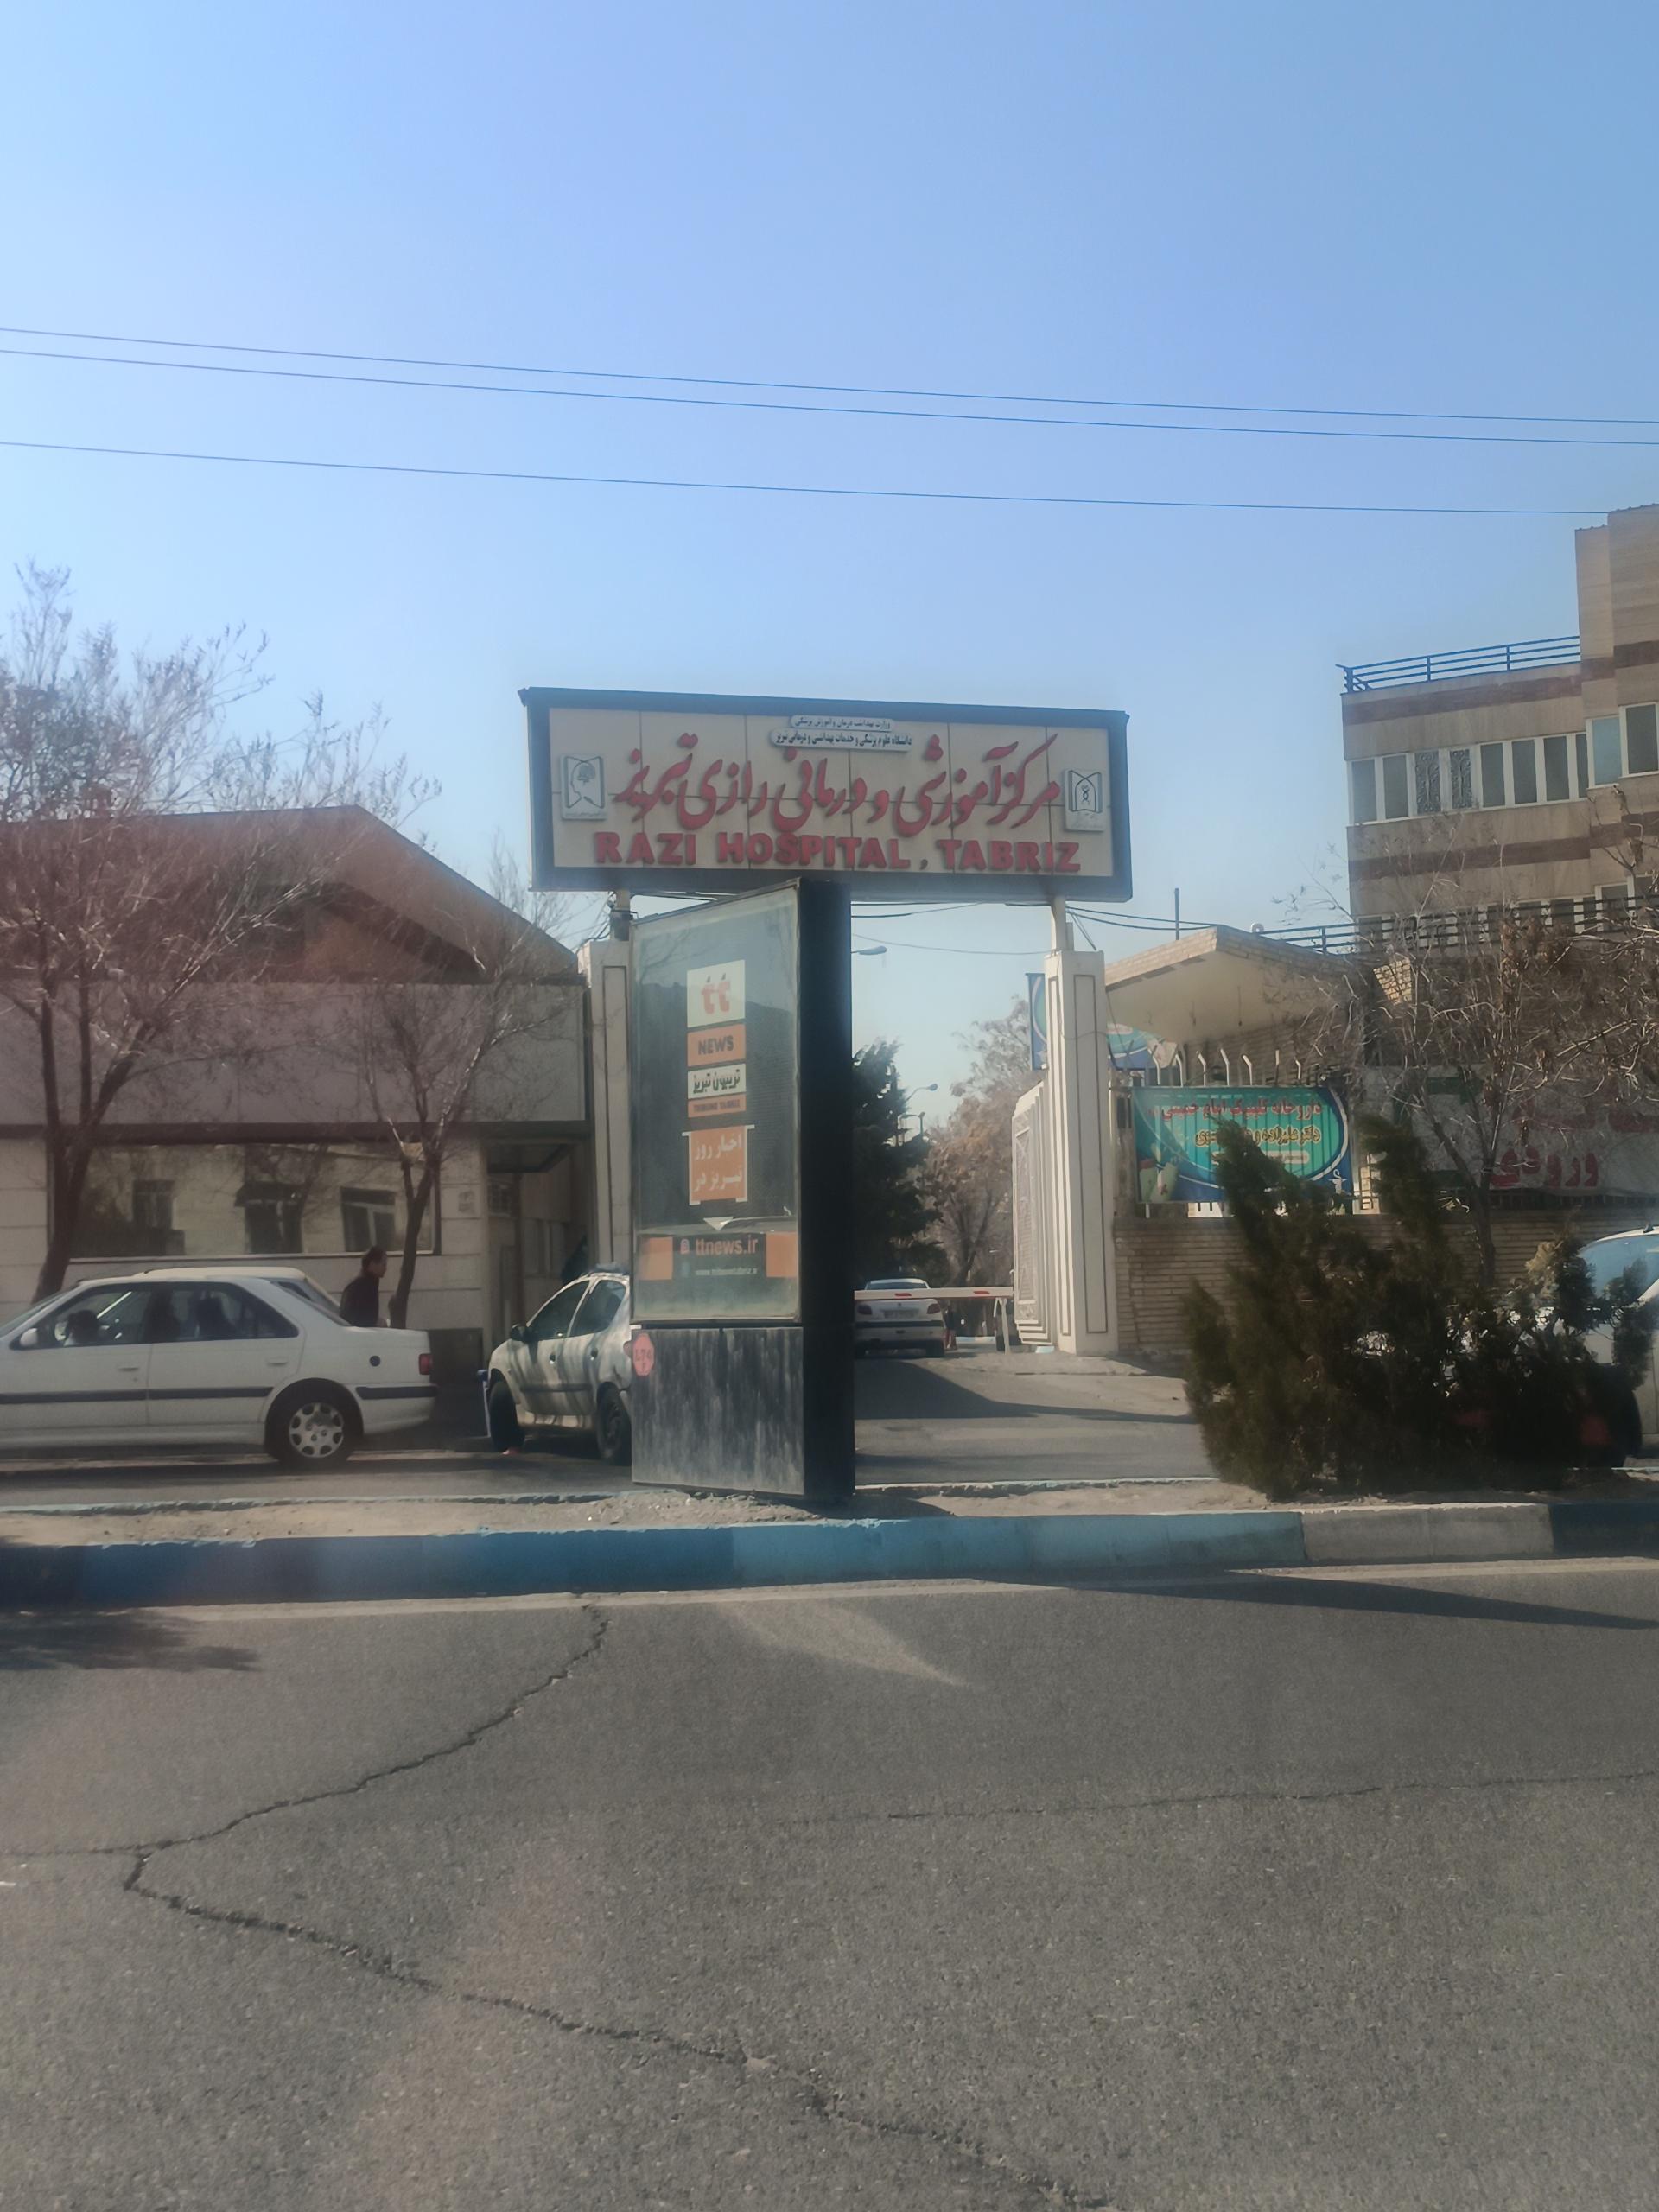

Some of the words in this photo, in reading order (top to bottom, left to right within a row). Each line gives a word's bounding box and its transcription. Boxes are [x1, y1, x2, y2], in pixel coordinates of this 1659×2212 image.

[611, 732, 699, 823] تبریز
[677, 758, 769, 830] رازی
[774, 747, 868, 832] درمانی
[893, 734, 1020, 837] آموزشی
[986, 733, 1061, 830] مرکز
[866, 790, 890, 824] و
[594, 830, 697, 865] RAZI
[936, 838, 1081, 873] TABRIZ
[697, 1034, 734, 1056] NEWS
[692, 1071, 711, 1095] تبریز
[712, 1068, 741, 1091] تریبون
